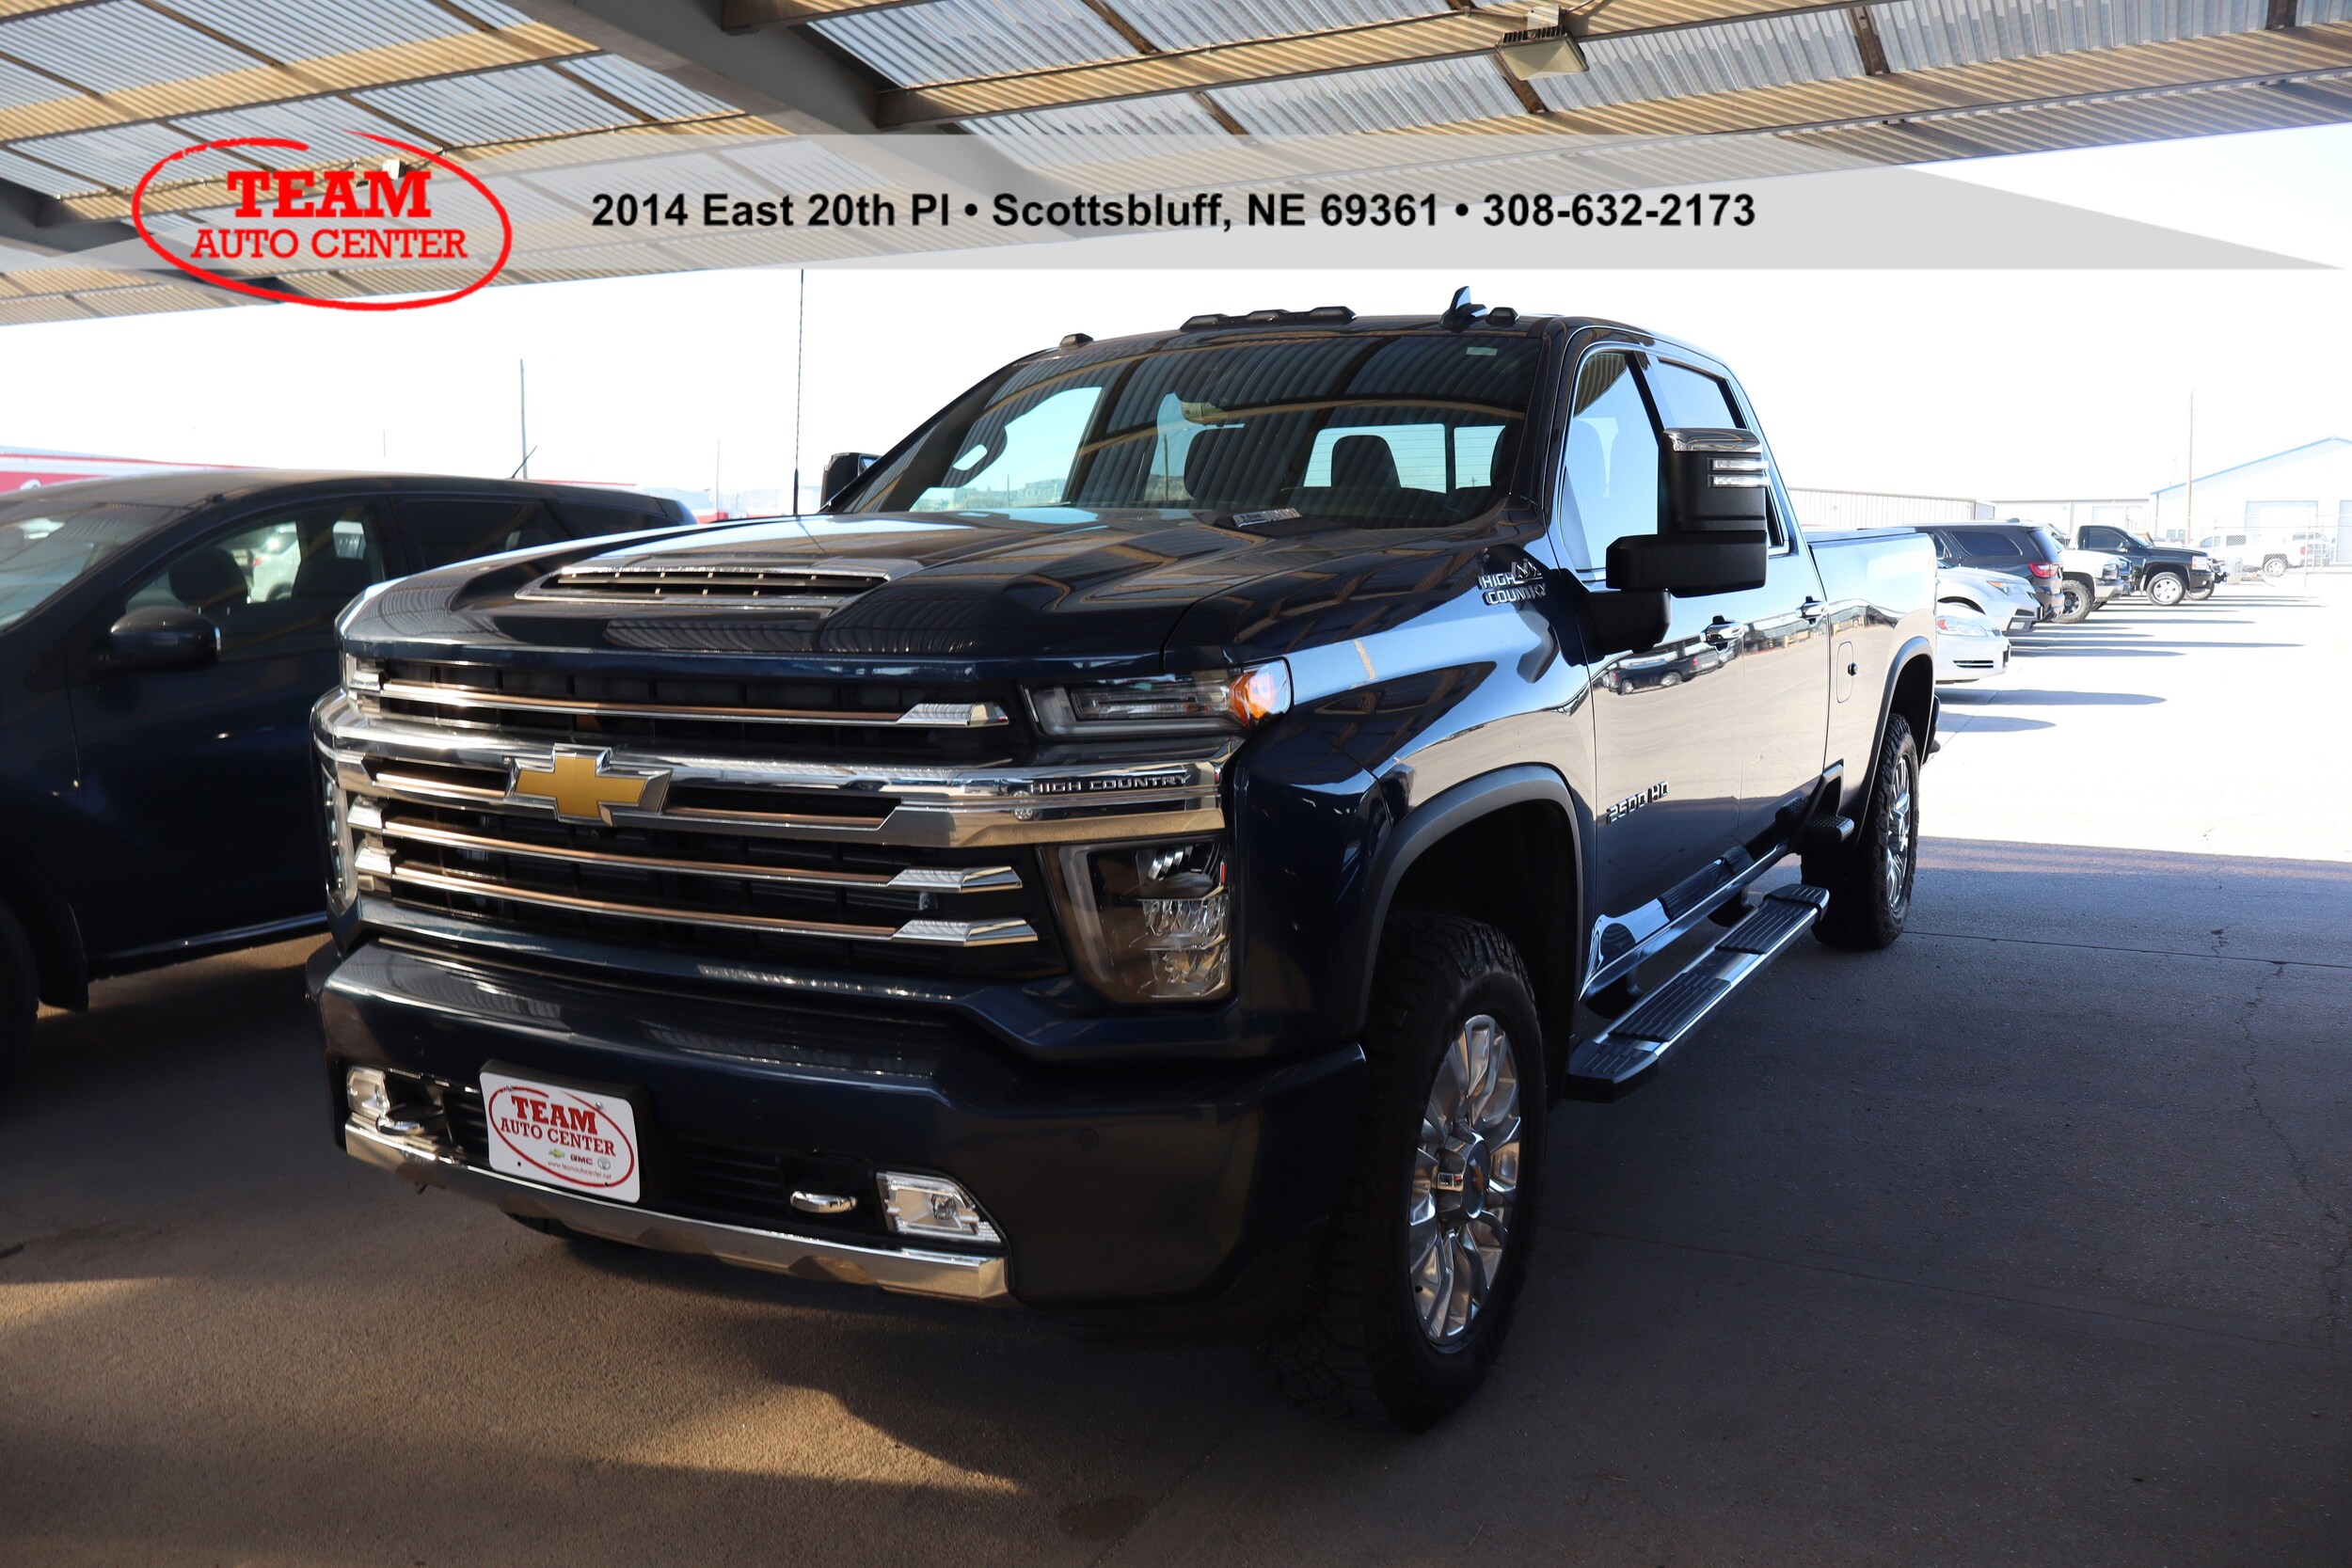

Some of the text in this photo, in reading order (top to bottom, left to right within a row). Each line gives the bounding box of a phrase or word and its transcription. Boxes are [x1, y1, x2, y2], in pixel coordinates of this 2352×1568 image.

[1478, 572, 1519, 590] HIGH
[1483, 583, 1546, 605] COUNTRY
[1029, 774, 1191, 794] HIGH COUNTRY
[1606, 780, 1669, 825] 2500 HD
[511, 1095, 597, 1134] TEAM
[501, 1117, 616, 1157] AUTO CENTER
[570, 1154, 594, 1165] GMC
